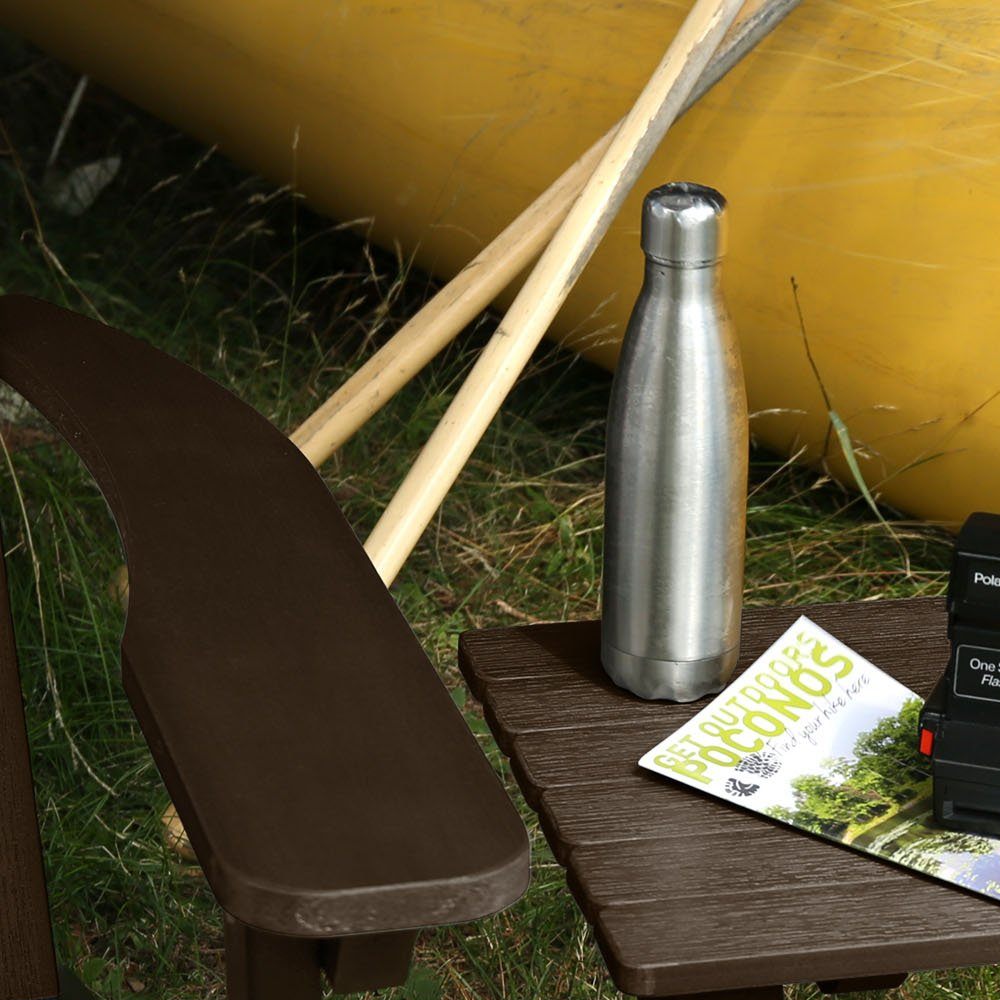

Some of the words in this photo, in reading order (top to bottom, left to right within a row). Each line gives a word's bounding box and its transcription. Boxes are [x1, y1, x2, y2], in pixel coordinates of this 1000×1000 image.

[970, 657, 996, 673] One
[672, 638, 854, 784] POCONOS
[653, 734, 703, 770] GET
